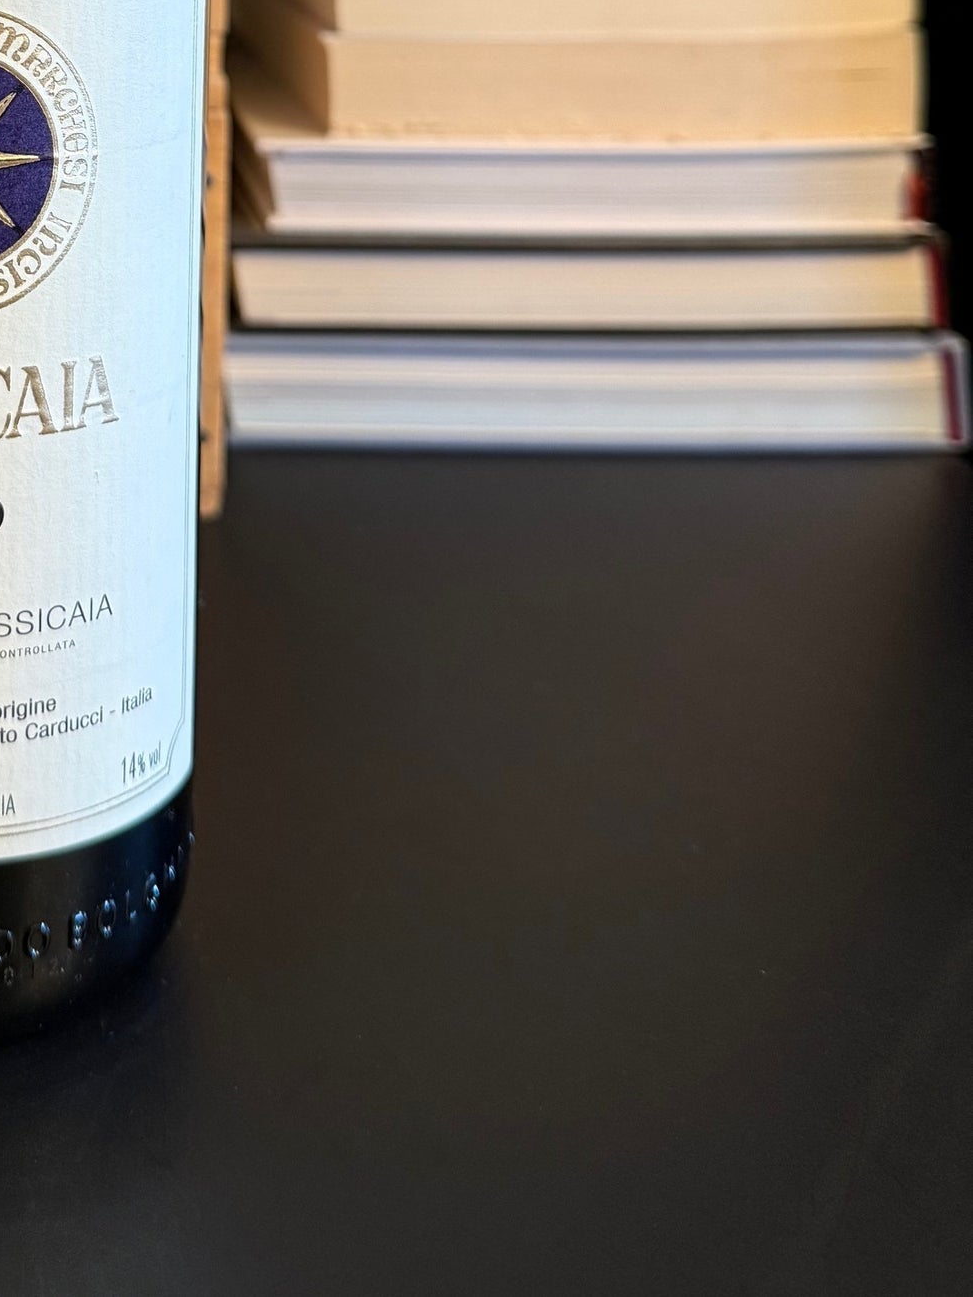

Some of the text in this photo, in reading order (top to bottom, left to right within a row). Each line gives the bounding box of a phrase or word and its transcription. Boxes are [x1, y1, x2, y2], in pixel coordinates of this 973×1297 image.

[25, 705, 104, 741] Carducci
[121, 686, 153, 716] Italia
[120, 741, 161, 784] 14% vol
